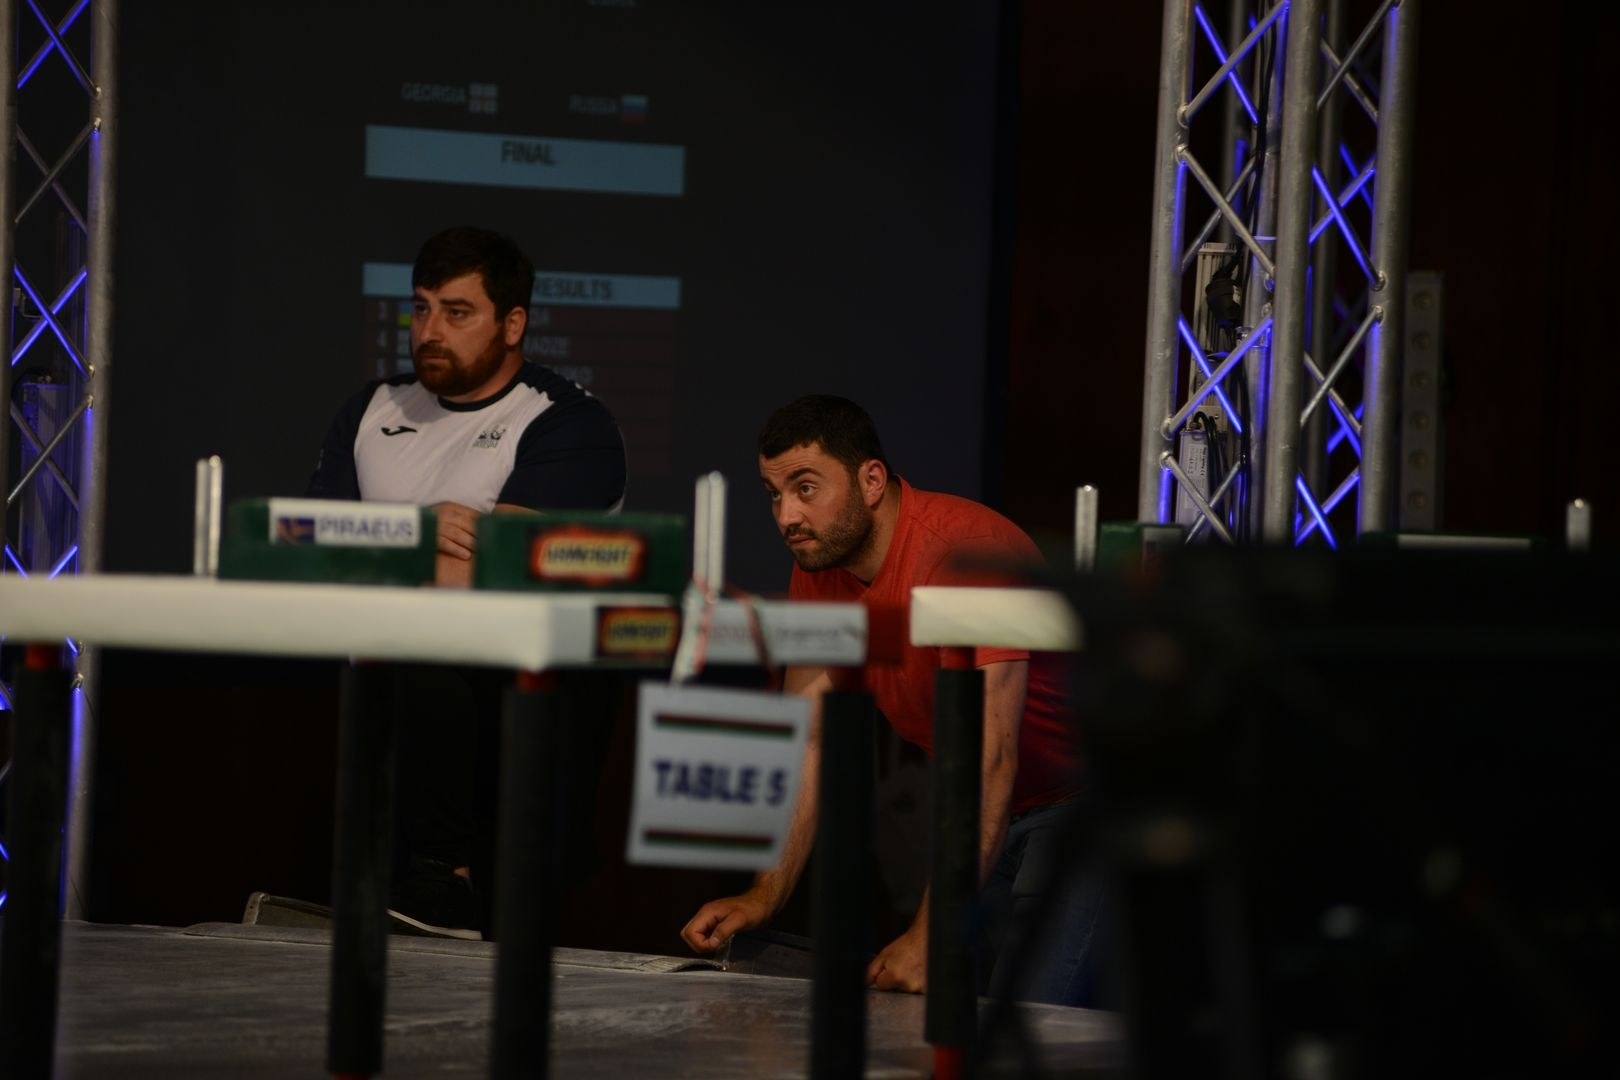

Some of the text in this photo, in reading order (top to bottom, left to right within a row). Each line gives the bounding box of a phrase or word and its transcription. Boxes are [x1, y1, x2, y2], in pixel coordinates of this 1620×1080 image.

[401, 82, 466, 104] GEORGIA
[501, 140, 556, 166] FINAL
[534, 275, 614, 300] RESULTS
[319, 514, 414, 541] PIRAEUS
[655, 758, 788, 806] TABLE 5
